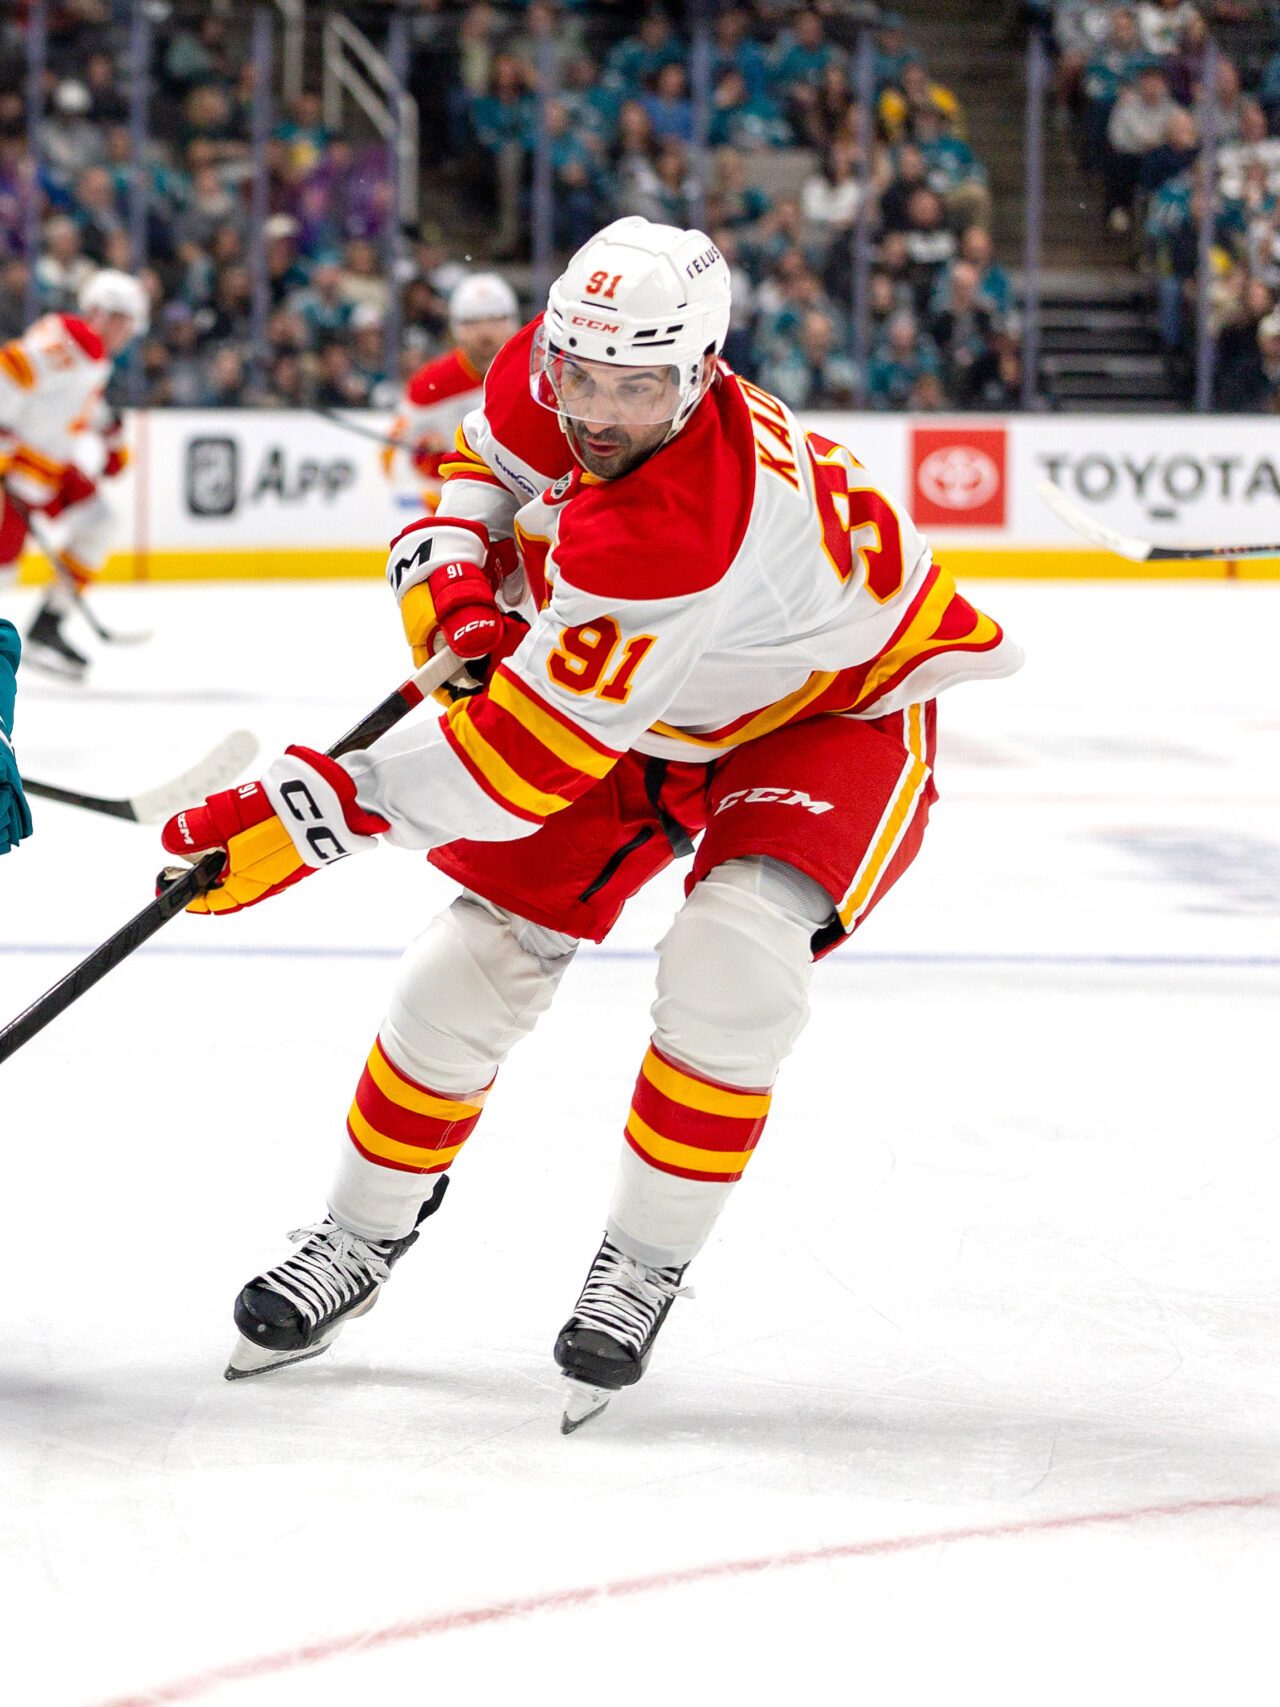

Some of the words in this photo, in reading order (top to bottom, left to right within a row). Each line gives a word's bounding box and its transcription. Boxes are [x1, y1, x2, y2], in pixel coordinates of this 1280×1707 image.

[686, 246, 720, 279] TELUS
[585, 271, 623, 299] 91
[571, 316, 620, 334] CCM
[1037, 453, 1280, 504] TOYOTA
[446, 563, 464, 579] 91
[453, 619, 496, 641] CCM
[546, 613, 659, 705] 91
[714, 787, 835, 815] CCM
[279, 779, 352, 866] CC
